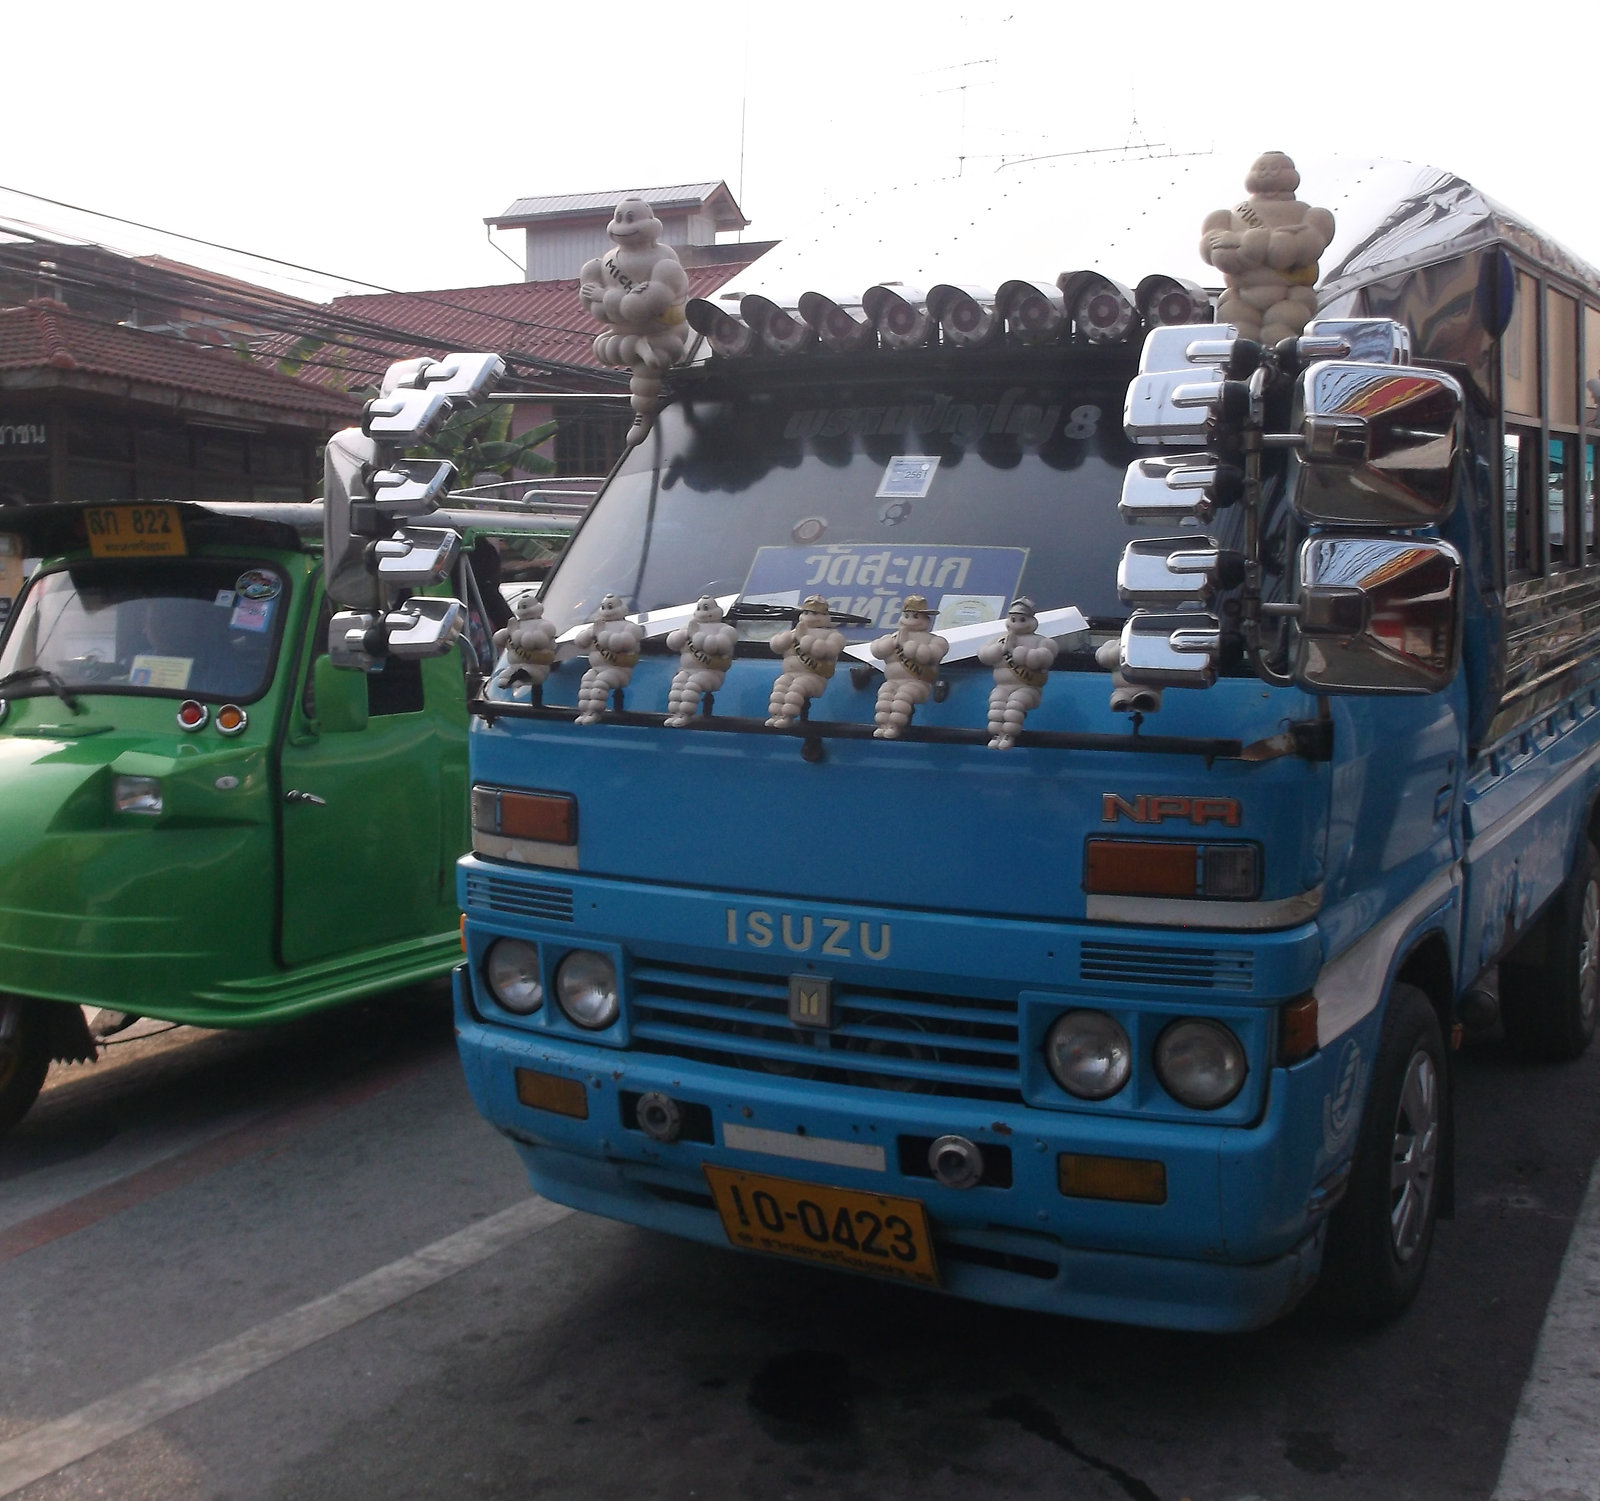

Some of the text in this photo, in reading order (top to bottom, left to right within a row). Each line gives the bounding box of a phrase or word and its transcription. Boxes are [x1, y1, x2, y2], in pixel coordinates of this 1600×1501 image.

[1064, 404, 1102, 440] 8
[131, 507, 172, 535] 822
[805, 545, 972, 589] วัดสะแก
[1102, 793, 1243, 829] NPA
[727, 908, 892, 961] ISUZU
[730, 1184, 918, 1263] 10-0423
